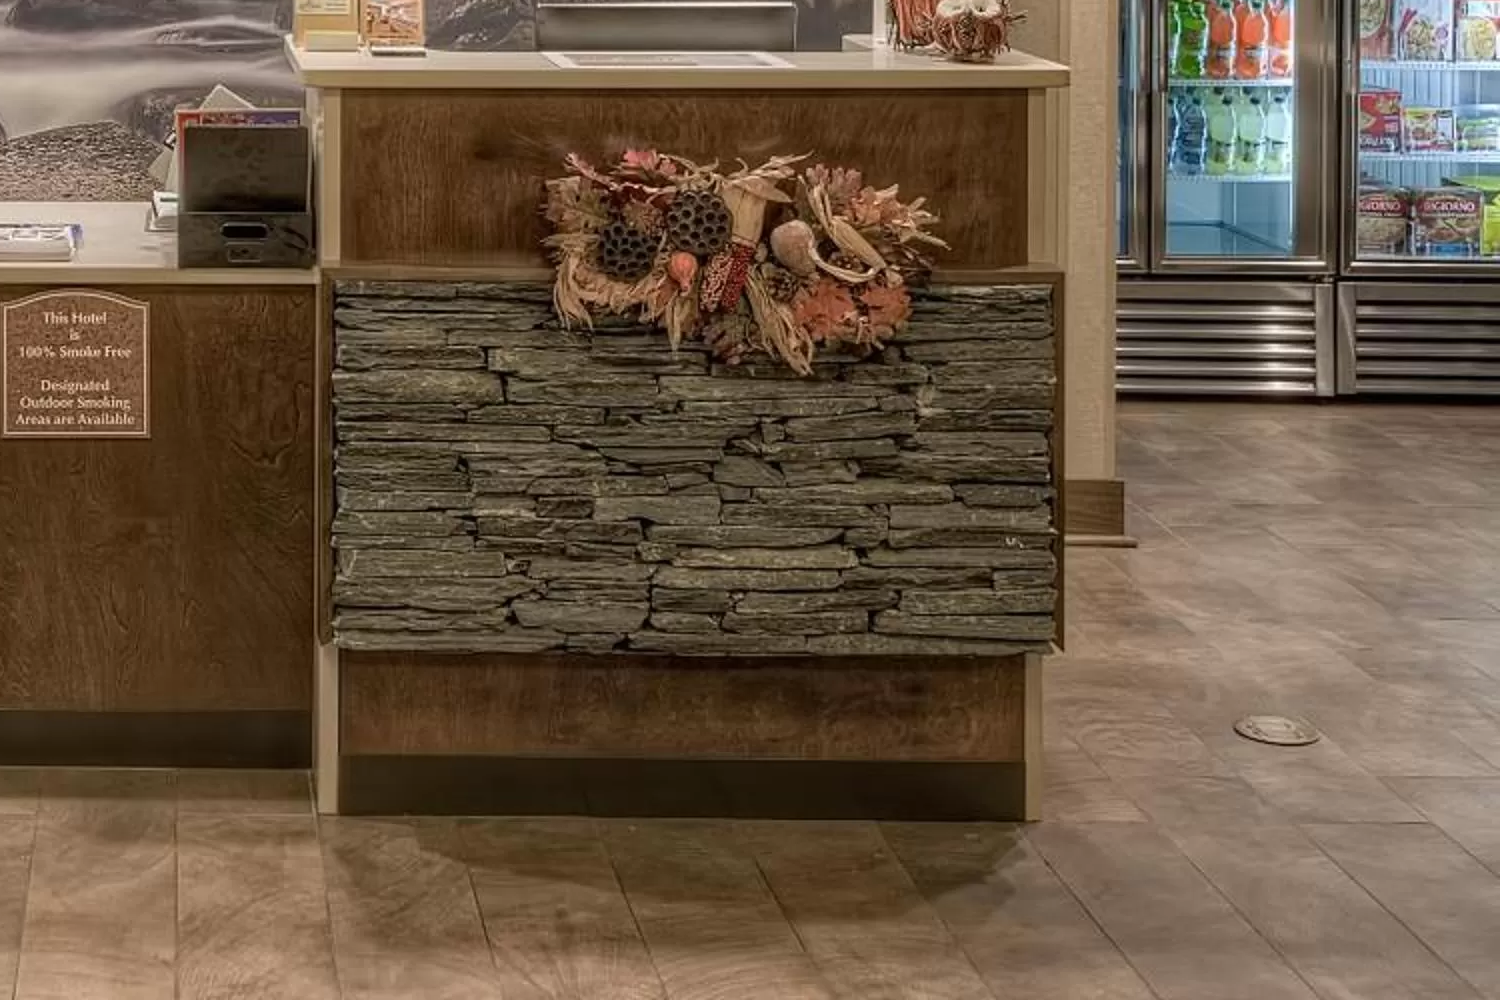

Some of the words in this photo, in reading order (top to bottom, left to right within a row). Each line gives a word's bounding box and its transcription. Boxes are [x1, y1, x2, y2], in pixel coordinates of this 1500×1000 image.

[44, 311, 69, 325] This
[72, 311, 107, 325] Hotel
[19, 345, 56, 358] 100%
[59, 345, 101, 358] Smoke
[104, 345, 132, 358] Free
[41, 378, 111, 395] Designated
[19, 395, 74, 409] Outdoor
[77, 395, 132, 411] Smoking
[15, 413, 51, 425] Areas
[53, 415, 75, 425] are
[77, 412, 135, 425] Available
